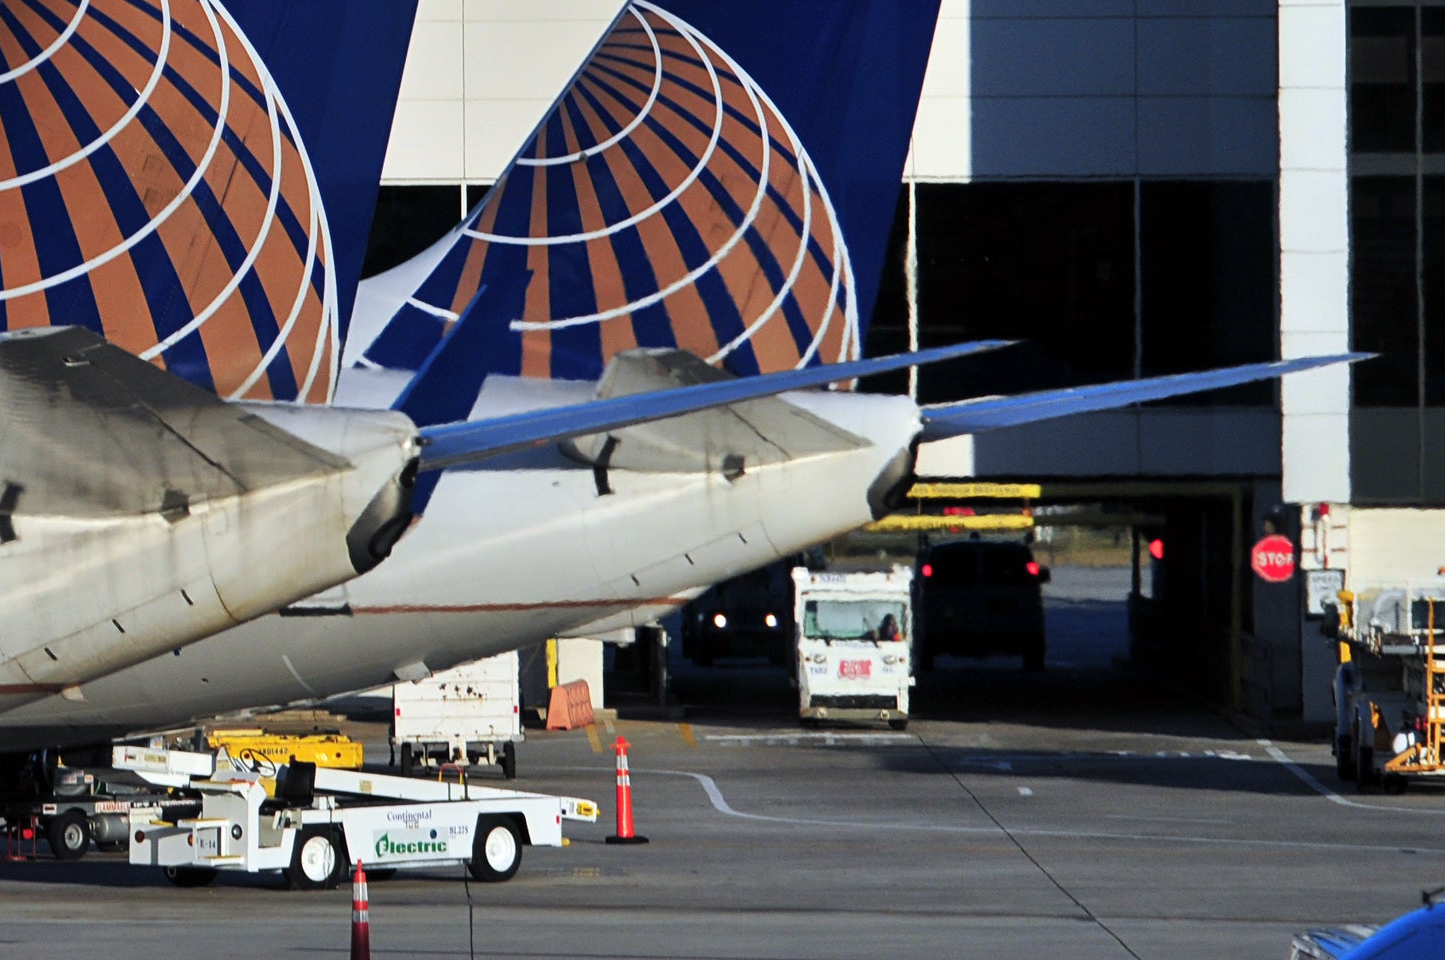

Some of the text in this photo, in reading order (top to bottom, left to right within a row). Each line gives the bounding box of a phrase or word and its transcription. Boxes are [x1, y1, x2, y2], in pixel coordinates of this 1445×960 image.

[1258, 552, 1294, 567] STOP
[387, 809, 432, 822] Continental
[375, 832, 447, 858] Electric
